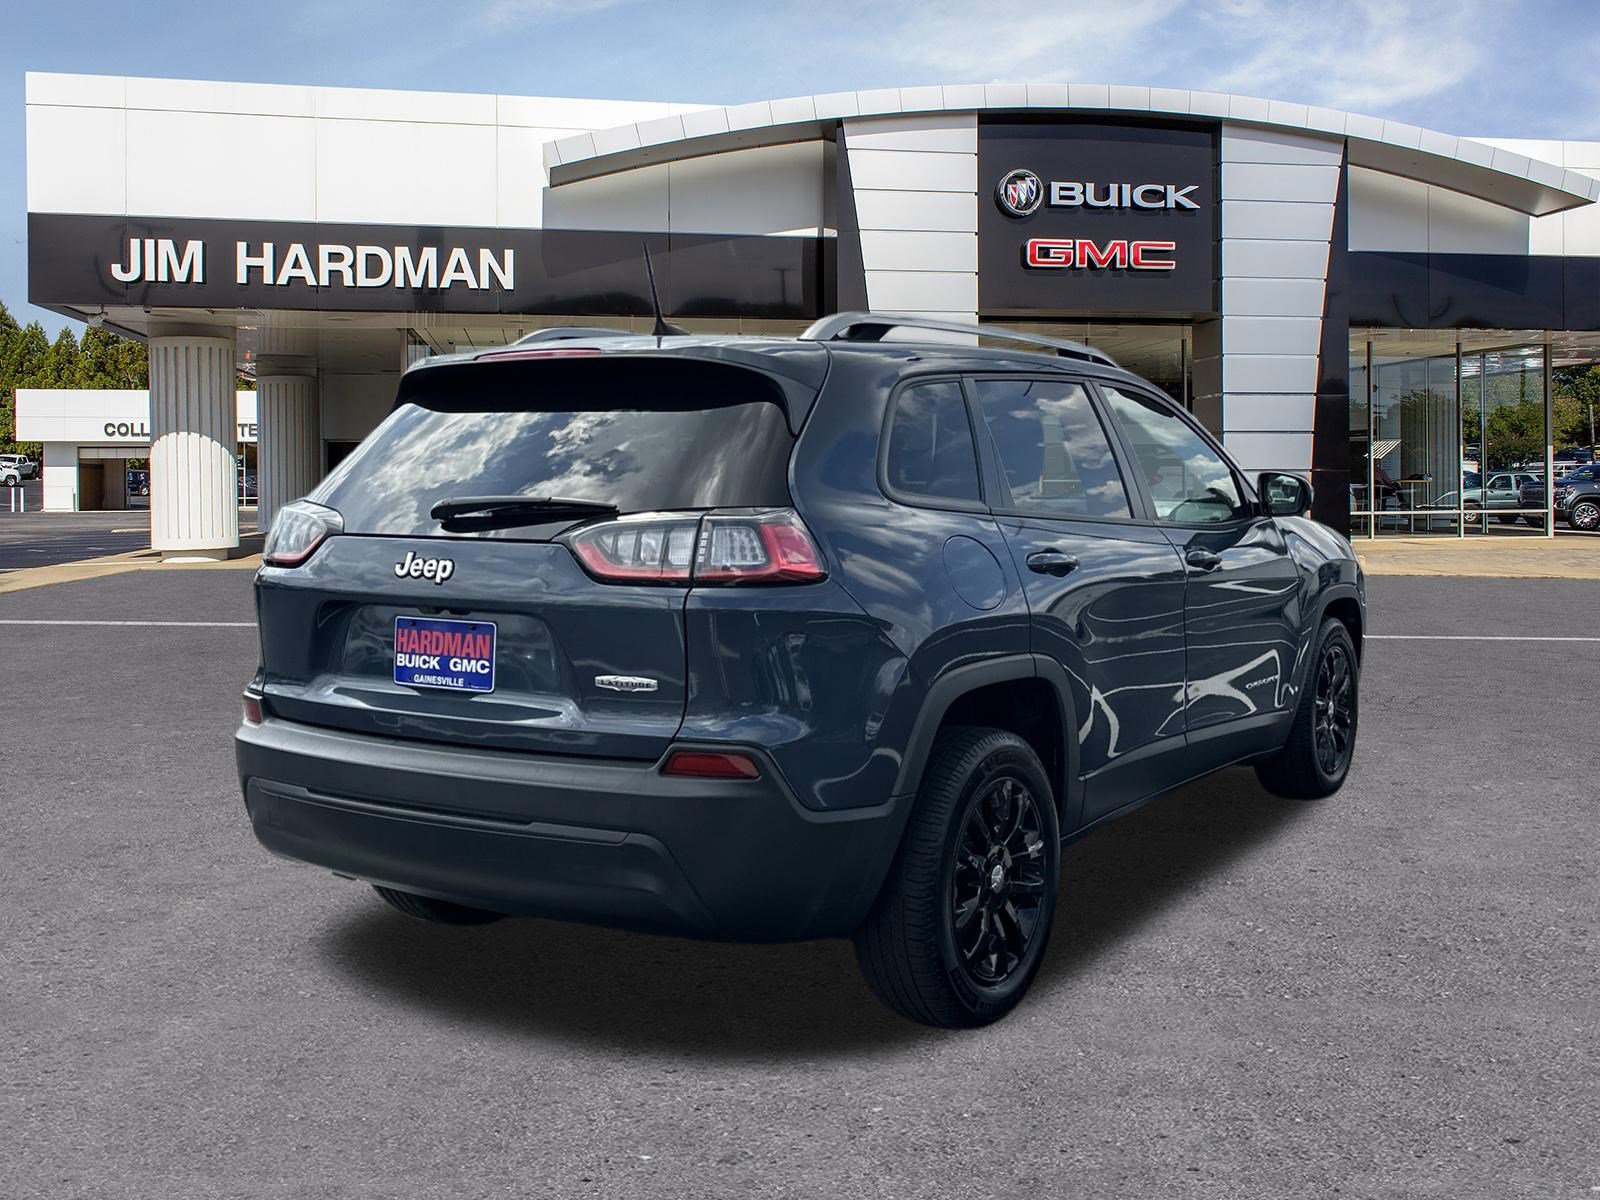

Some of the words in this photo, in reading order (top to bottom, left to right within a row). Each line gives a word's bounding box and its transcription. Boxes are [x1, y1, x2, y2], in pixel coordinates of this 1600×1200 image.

[1050, 181, 1200, 208] BUICK
[111, 238, 204, 283] JIM
[236, 241, 515, 290] HARDMAN
[1025, 238, 1176, 270] GMC
[394, 551, 454, 584] Jeep
[397, 628, 491, 659] HARDMAN
[396, 653, 440, 670] BUICK
[449, 658, 490, 674] GMC
[413, 674, 464, 686] GAINESVILLE
